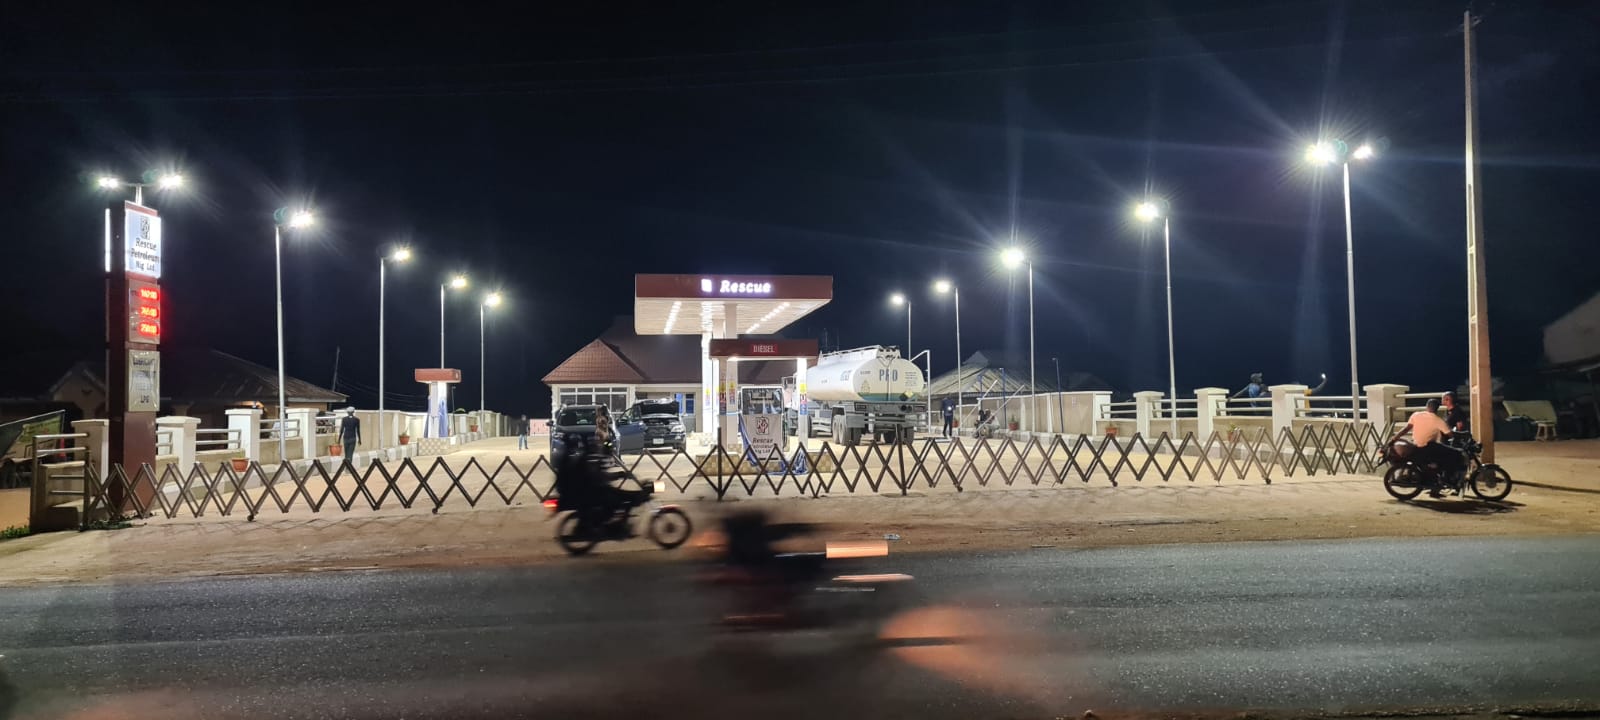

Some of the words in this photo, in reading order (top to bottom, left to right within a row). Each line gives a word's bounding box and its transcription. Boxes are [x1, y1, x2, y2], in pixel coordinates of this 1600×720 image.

[135, 237, 157, 251] Rescue
[131, 248, 160, 264] Petroleum
[719, 279, 772, 293] Rescue
[752, 344, 776, 353] DIESEL
